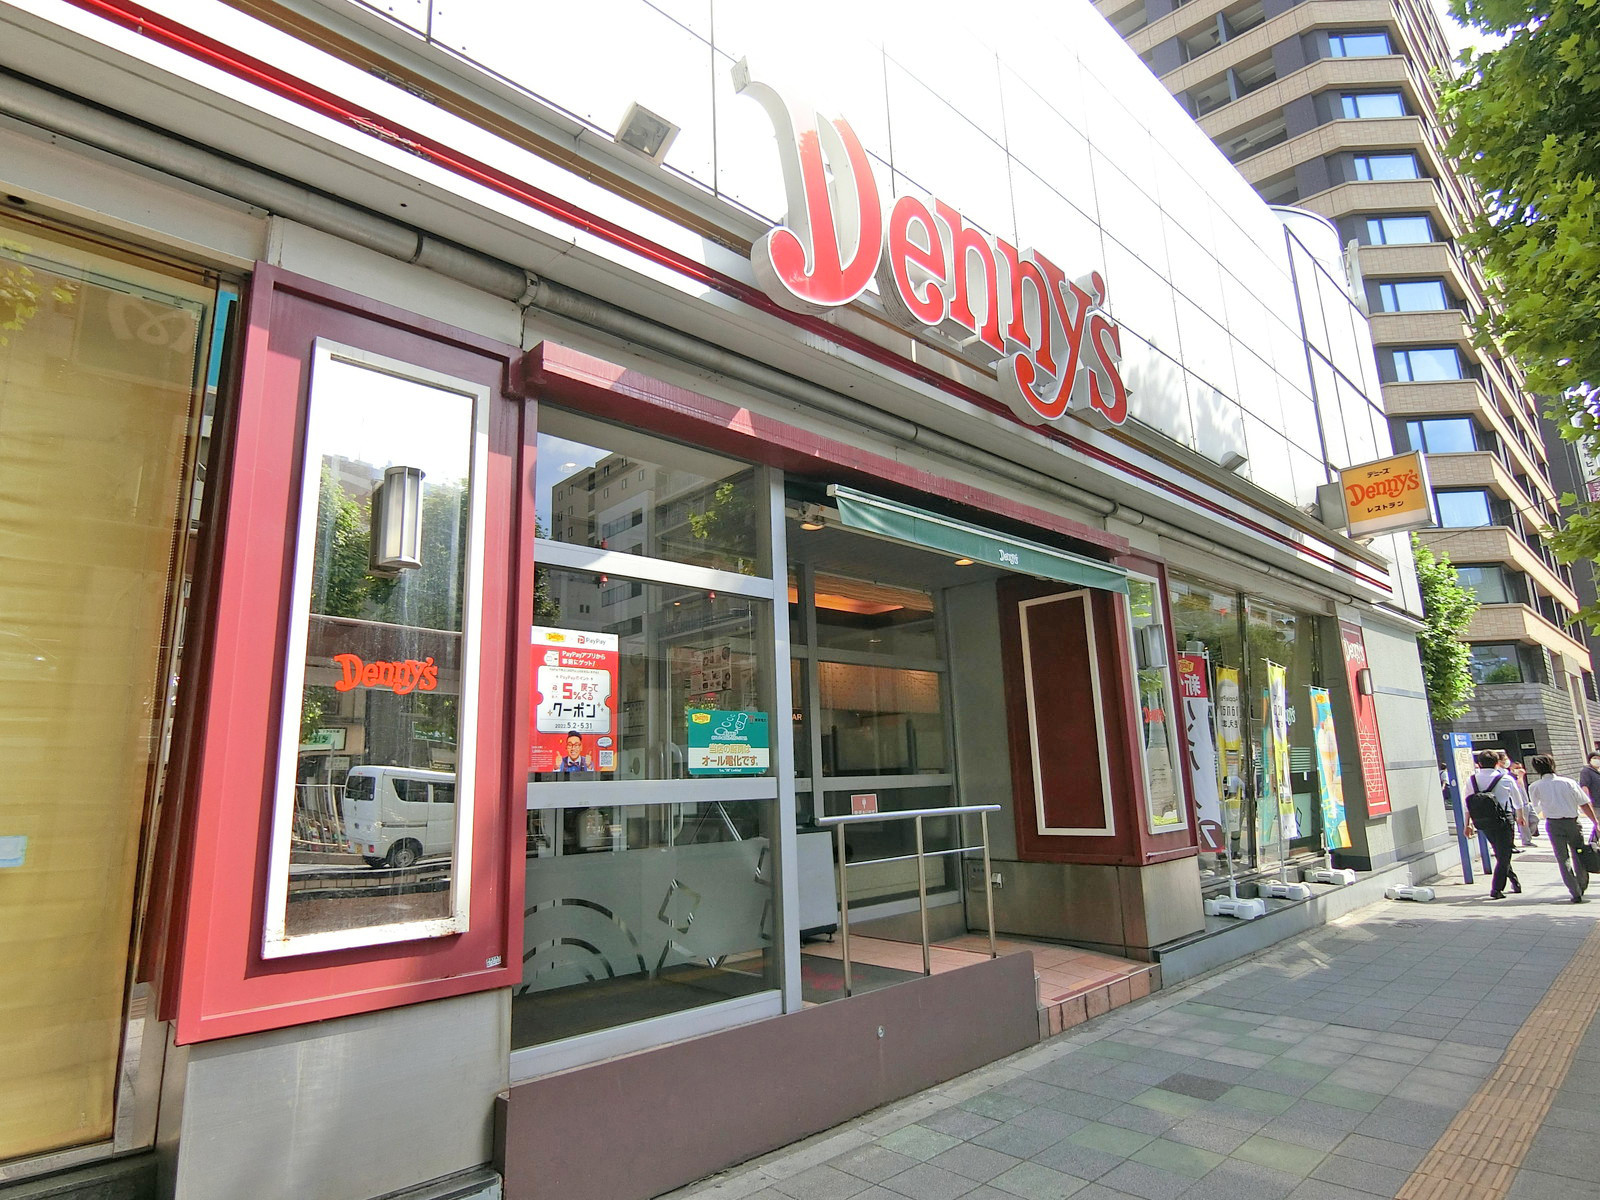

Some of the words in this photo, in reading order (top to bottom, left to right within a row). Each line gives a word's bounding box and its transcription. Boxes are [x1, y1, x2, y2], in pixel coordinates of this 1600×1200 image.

[733, 56, 1128, 427] Denny's
[1367, 468, 1390, 478] デニーズ
[1346, 469, 1420, 506] Denny's
[1367, 500, 1404, 513] レストラン
[585, 637, 607, 645] PayPay
[561, 650, 606, 660] PayPayアプリから
[333, 653, 438, 695] Denny's
[552, 702, 596, 718] クーポン
